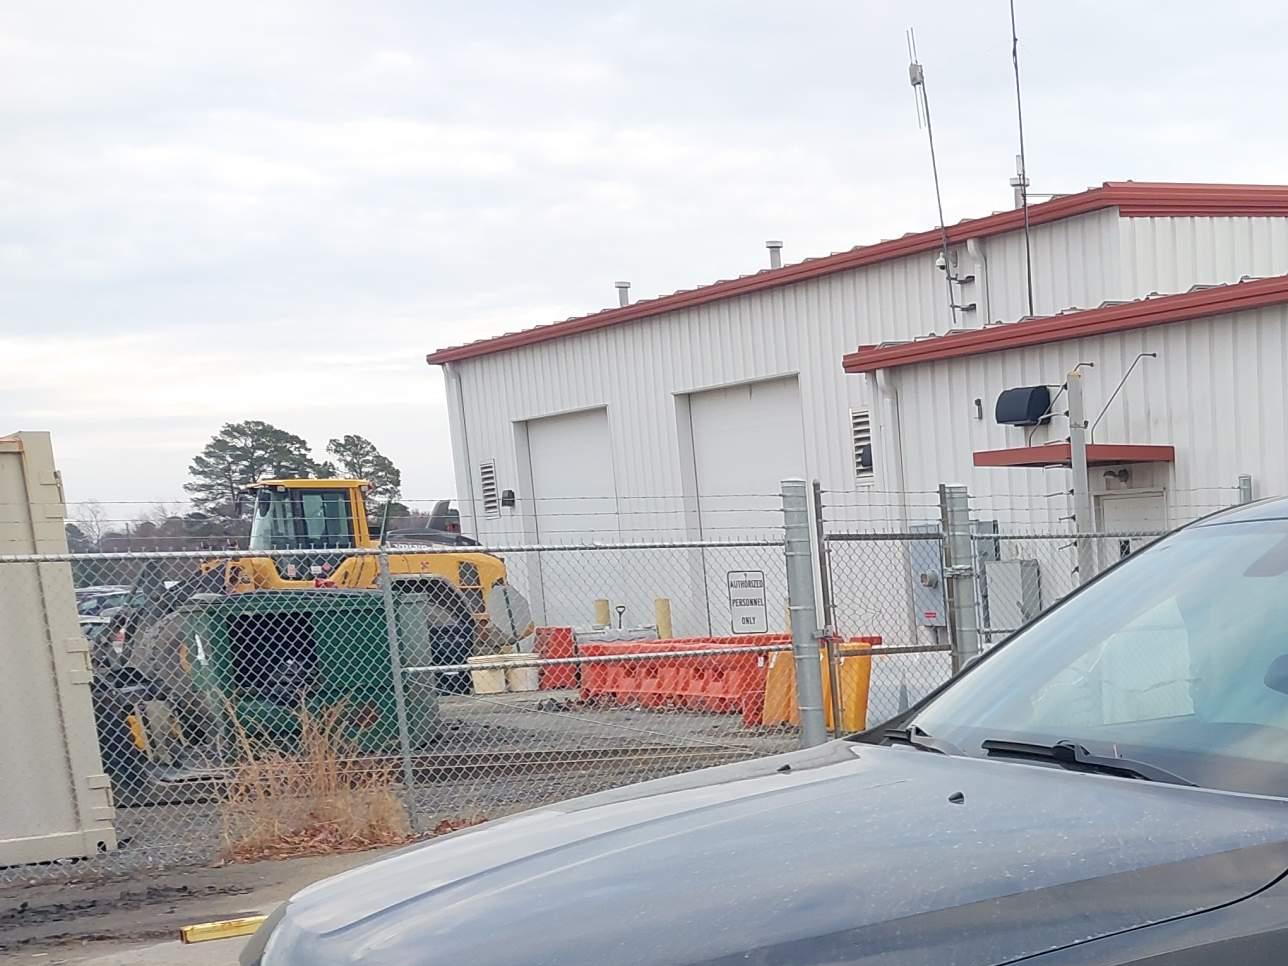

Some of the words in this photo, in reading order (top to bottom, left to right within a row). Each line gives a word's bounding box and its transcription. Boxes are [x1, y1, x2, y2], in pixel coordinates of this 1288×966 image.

[730, 579, 764, 588] AUTHORIZED
[732, 598, 764, 607] PERSONNEL
[741, 616, 756, 625] ONLY
